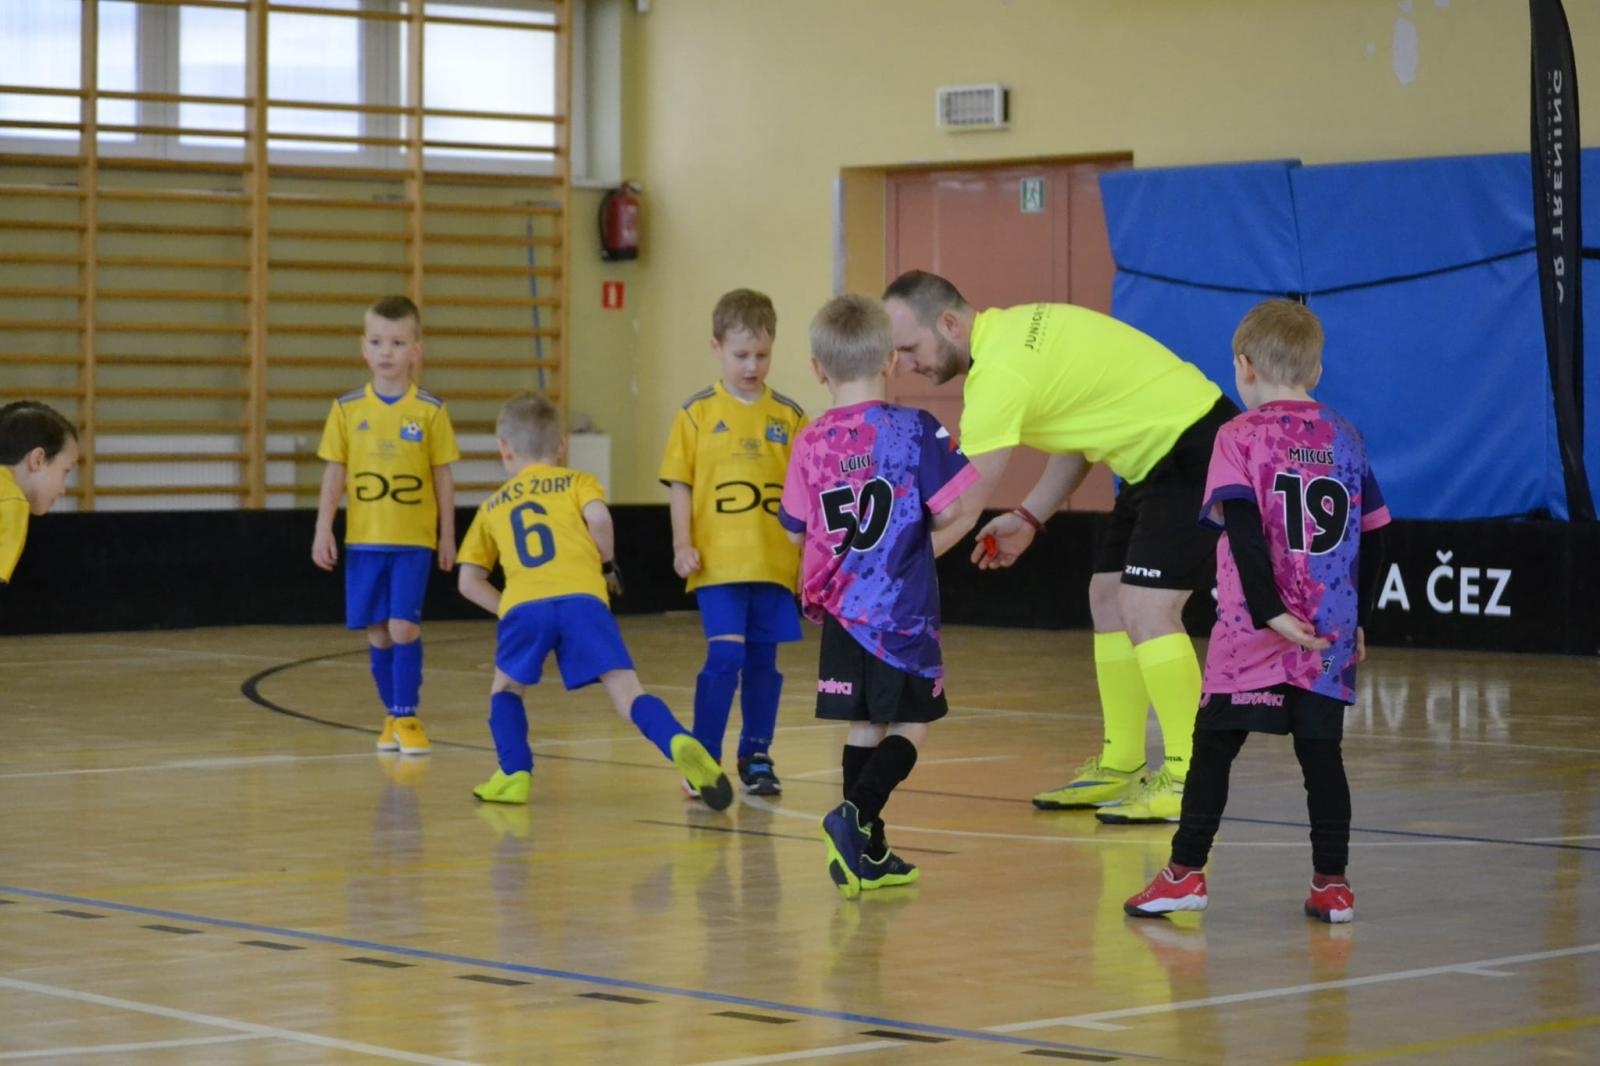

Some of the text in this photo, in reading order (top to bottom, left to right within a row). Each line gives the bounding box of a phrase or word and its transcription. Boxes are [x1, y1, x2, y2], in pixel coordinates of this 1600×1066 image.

[510, 501, 557, 568] 6
[819, 476, 894, 556] 50
[1273, 471, 1350, 555] 19
[1425, 549, 1512, 616] ČEZ
